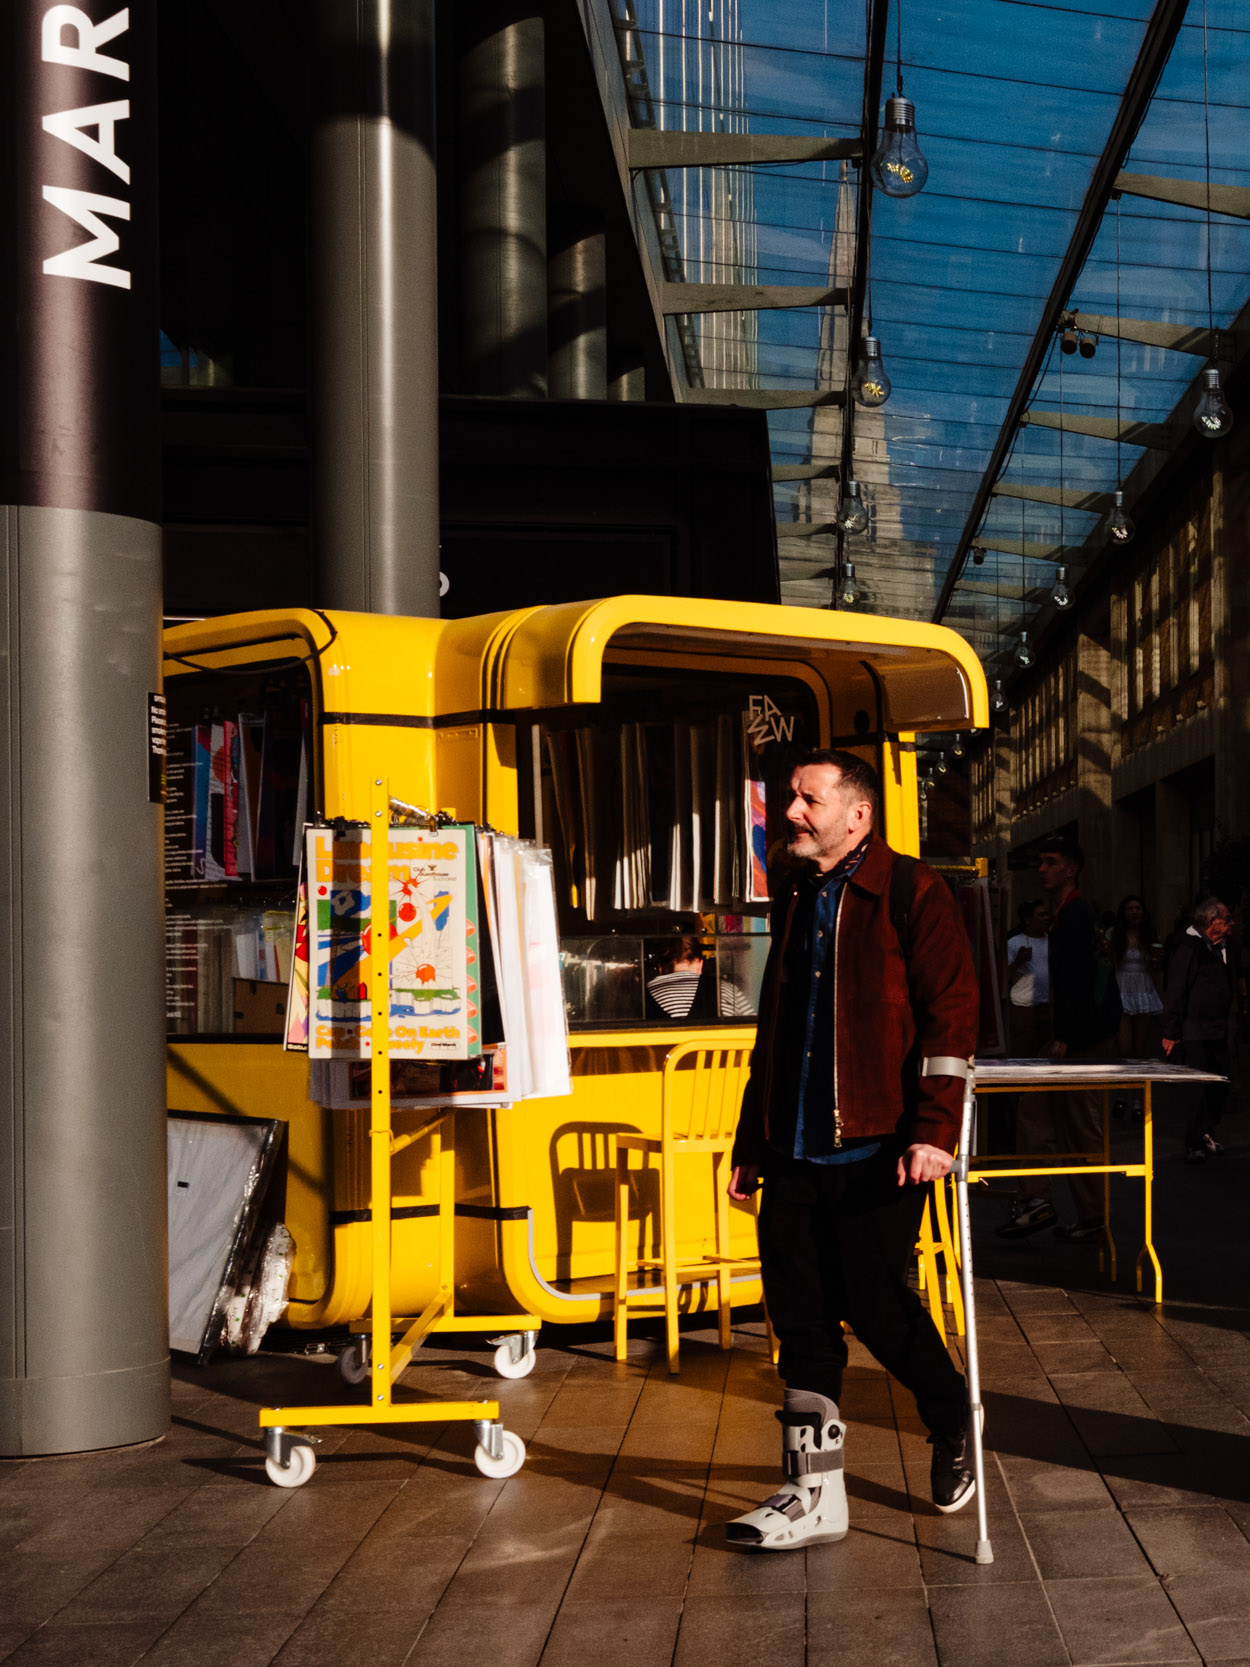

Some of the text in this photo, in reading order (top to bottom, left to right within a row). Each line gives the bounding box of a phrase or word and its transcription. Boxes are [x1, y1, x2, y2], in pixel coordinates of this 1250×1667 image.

[41, 4, 131, 290] MAR
[395, 1026, 417, 1039] On
[418, 1026, 461, 1038] Earth
